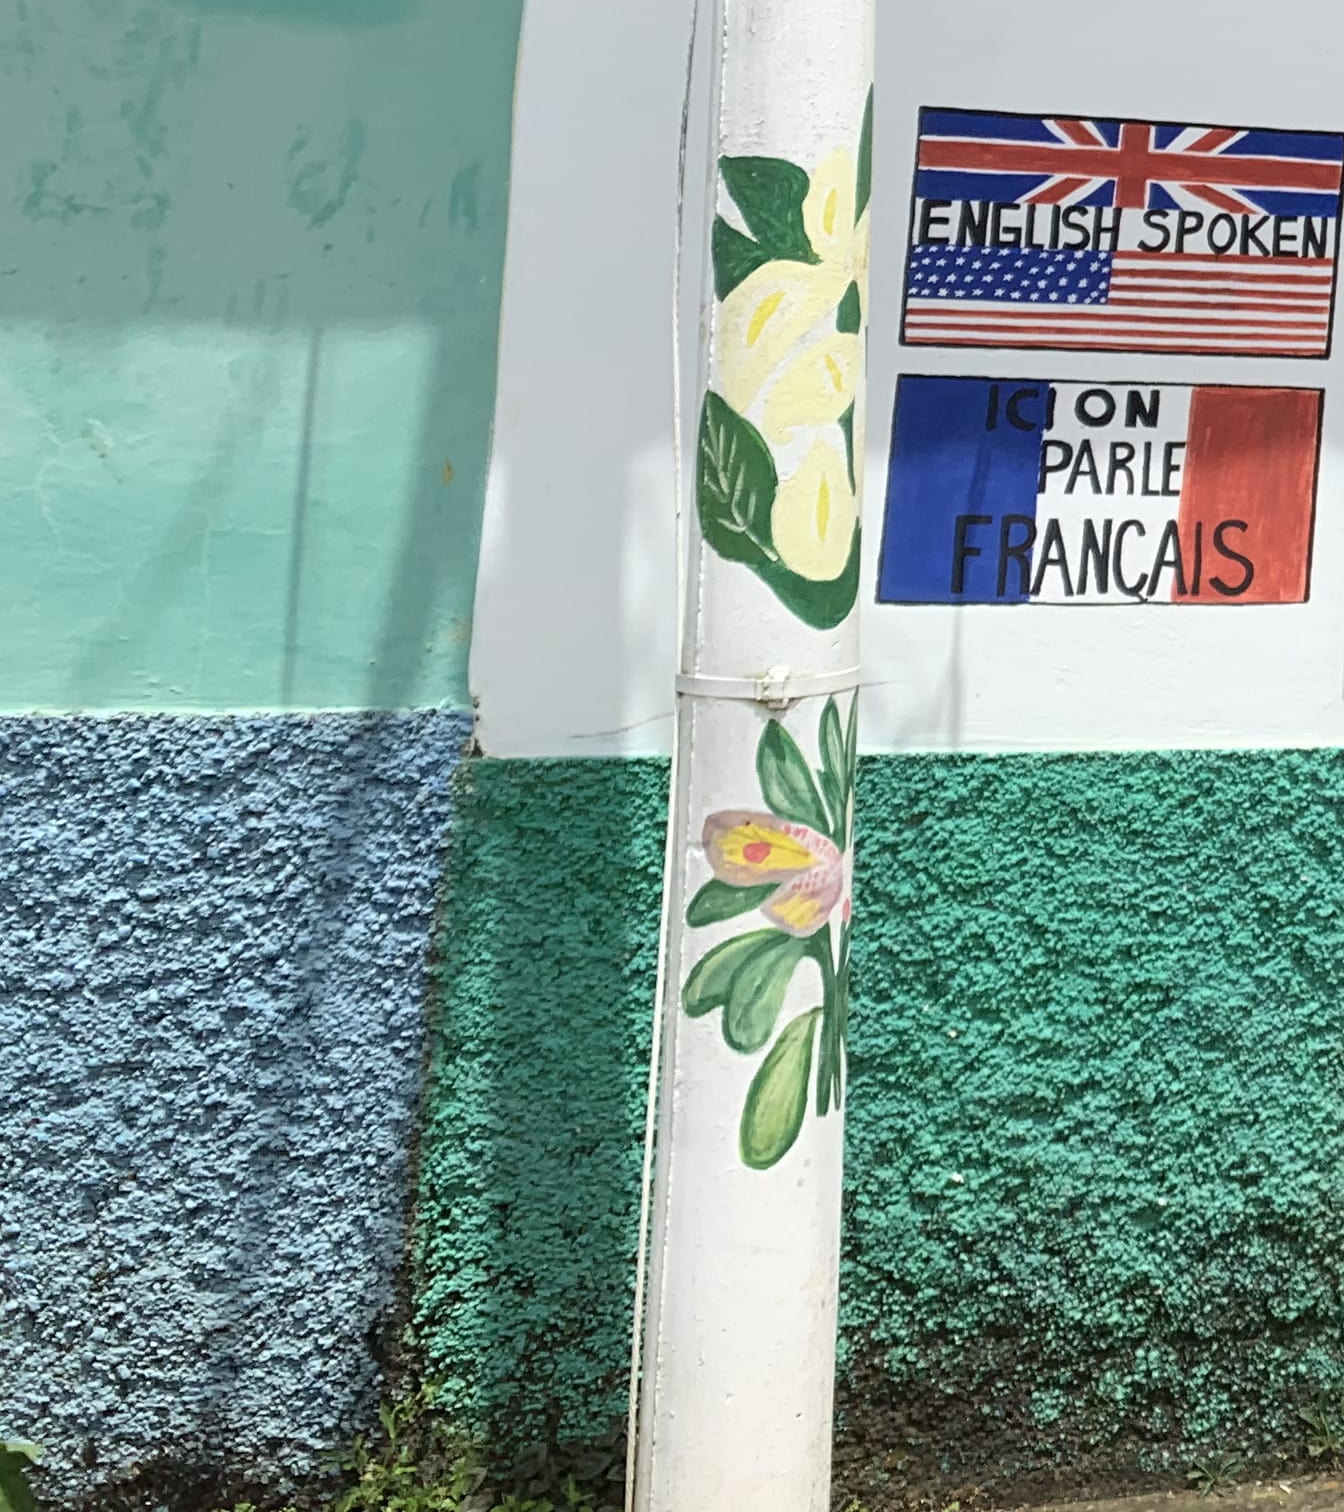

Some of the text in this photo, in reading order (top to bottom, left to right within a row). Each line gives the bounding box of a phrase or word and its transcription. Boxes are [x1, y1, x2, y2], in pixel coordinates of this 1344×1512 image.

[918, 198, 1328, 258] ENGLISH SPOKEN
[986, 384, 1160, 431] ICI ON
[1037, 439, 1188, 497] PARLE
[951, 514, 1255, 603] FRANÇAIS
